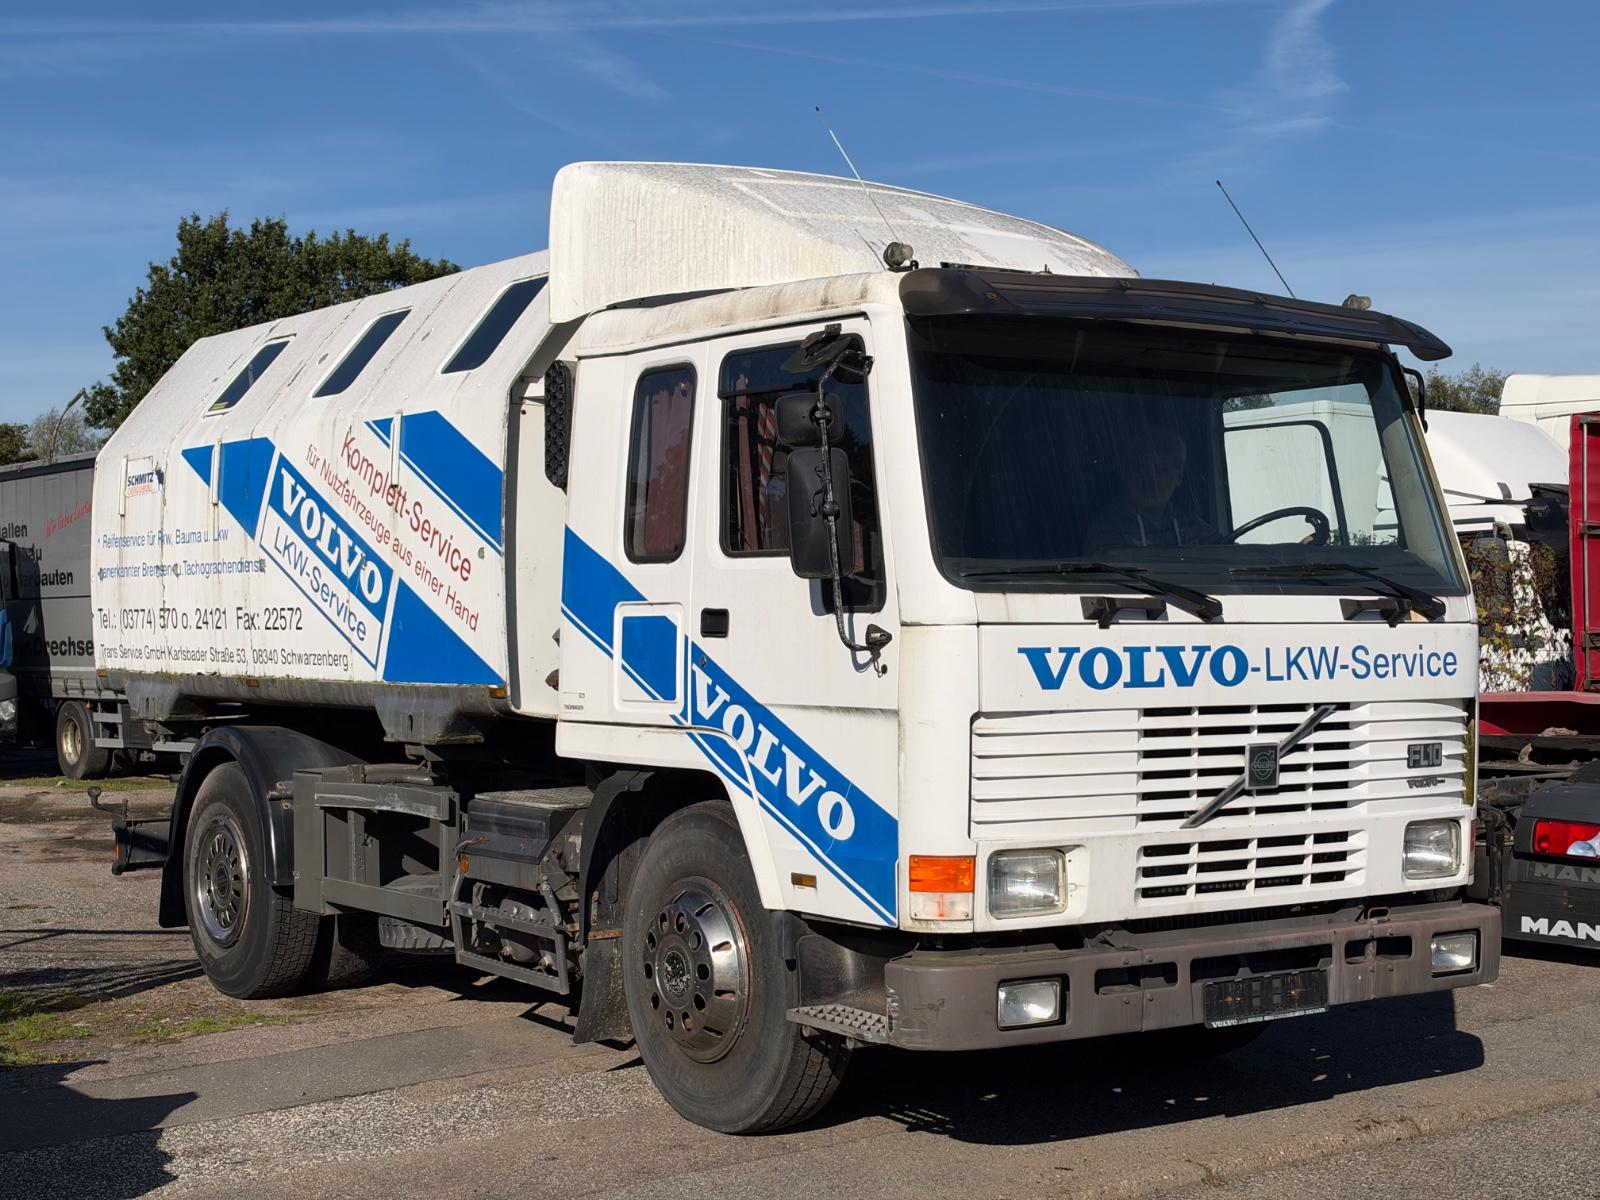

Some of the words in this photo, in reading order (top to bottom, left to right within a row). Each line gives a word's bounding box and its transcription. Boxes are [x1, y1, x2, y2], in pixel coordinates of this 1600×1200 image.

[127, 471, 154, 487] SCHMITZ
[341, 430, 471, 581] Komplett-Service
[0, 522, 28, 539] allen
[102, 531, 146, 551] Reifenservice
[146, 530, 156, 547] für
[203, 531, 211, 543] u.
[213, 527, 229, 542] Lkw
[281, 467, 383, 604] VOLVO
[306, 443, 320, 470] für
[320, 458, 391, 545] Nutzfahrzeuge
[392, 537, 413, 567] aus
[414, 560, 444, 597] einer
[445, 585, 479, 632] Hand
[274, 526, 367, 641] LKW-Service
[97, 608, 117, 629] Tel.:
[120, 607, 156, 635] (03774)
[159, 607, 178, 630] 570
[181, 612, 192, 630] o.
[195, 607, 228, 630] 24121
[236, 606, 260, 630] Fax:
[263, 607, 303, 630] 22572
[100, 643, 118, 659] Trans
[119, 644, 143, 660] Service
[144, 645, 167, 661] GmbH
[167, 645, 208, 661] Karlsbader
[209, 646, 235, 663] Straße
[252, 648, 279, 665] 08340
[280, 648, 349, 671] Schwarzenberg
[1017, 643, 1458, 691] VOLVO-LKW-Service
[691, 663, 856, 841] VOLVO
[1409, 743, 1441, 767] FL10
[1534, 862, 1600, 883] MAN
[1521, 916, 1600, 942] MAN
[1211, 1019, 1238, 1029] VOLVO
